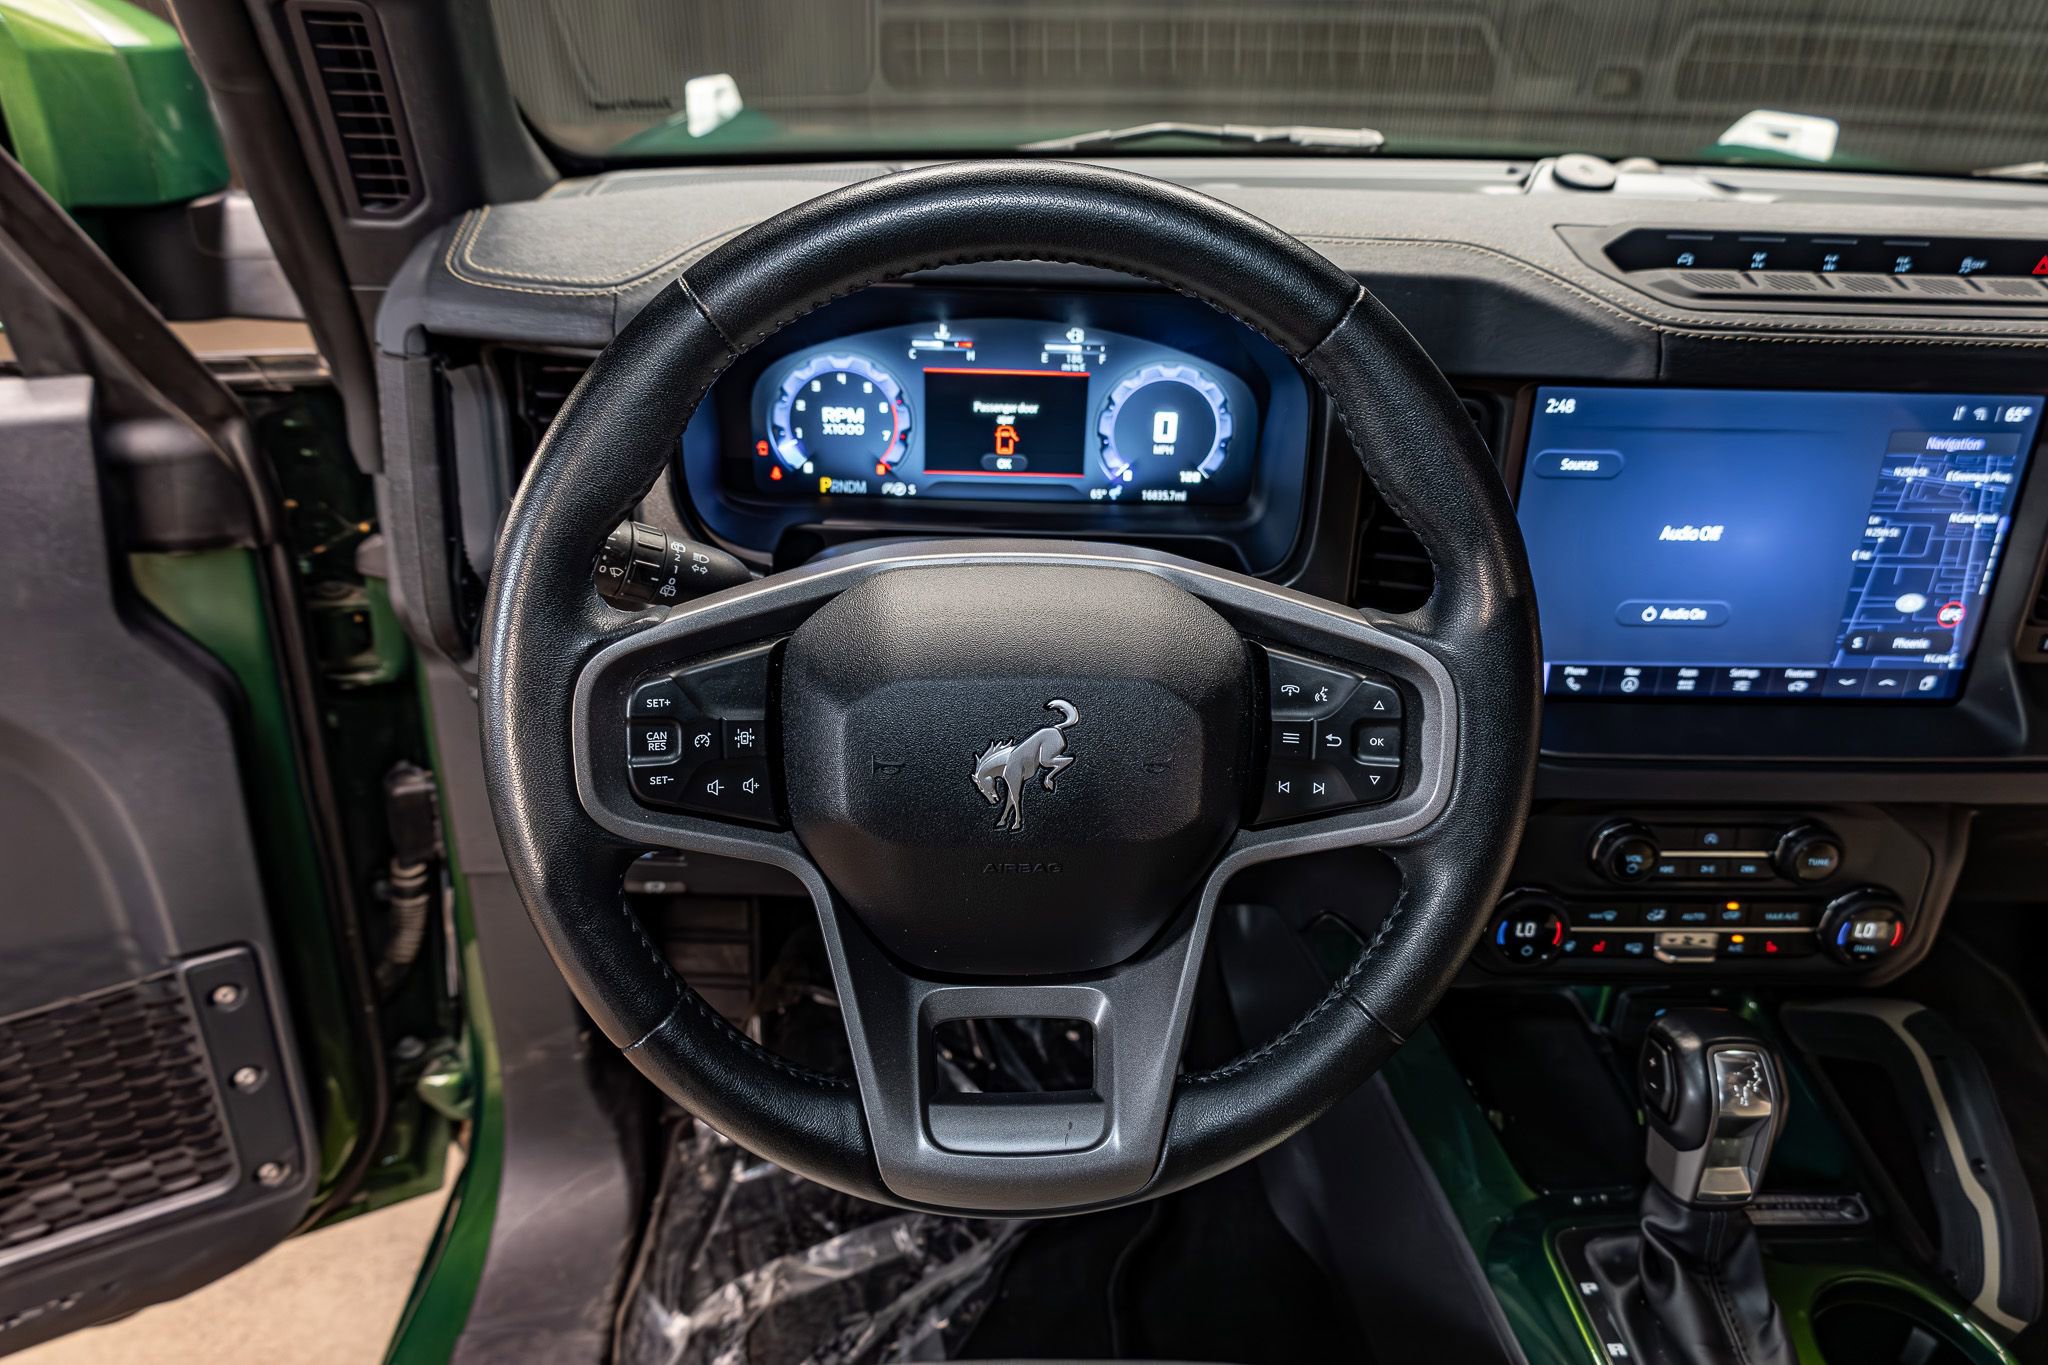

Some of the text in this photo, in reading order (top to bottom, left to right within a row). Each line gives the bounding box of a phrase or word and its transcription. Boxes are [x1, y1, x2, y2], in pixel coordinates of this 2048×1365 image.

[908, 348, 917, 360] C
[966, 350, 975, 361] H
[1041, 352, 1048, 363] E
[837, 373, 846, 384] 4
[811, 380, 821, 392] 3
[879, 402, 889, 413] 6
[973, 400, 1039, 415] Passenger door
[1545, 398, 1576, 414] 2:48
[821, 407, 865, 424] RPM
[795, 427, 803, 439] 1
[1153, 411, 1179, 443] 0
[882, 430, 891, 441] 7
[1153, 444, 1175, 456] MPH
[1925, 436, 1986, 452] Navigation
[803, 461, 813, 474] 0
[996, 458, 1012, 470] OK
[1559, 457, 1599, 472] Sources
[1122, 469, 1133, 482] 0
[1659, 525, 1725, 541] Audio Off
[674, 554, 681, 562] 2
[674, 565, 678, 574] 1
[1659, 607, 1708, 620] Audio On
[1939, 607, 1964, 622] GPS
[1851, 636, 1864, 649] S
[1892, 637, 1931, 649] Phoenix
[1564, 666, 1589, 676] Phone
[1729, 667, 1761, 679] Settings
[646, 699, 671, 708] SET+
[646, 731, 667, 740] CAN
[648, 742, 667, 751] RES
[1369, 738, 1384, 747] OK
[983, 862, 1064, 874] AIRBAG
[1808, 857, 1830, 867] TUNE
[1681, 911, 1707, 921] AUTO
[1515, 922, 1536, 937] LO
[1854, 922, 1876, 938] LO
[1580, 1282, 1599, 1295] P
[1607, 1343, 1628, 1357] R
